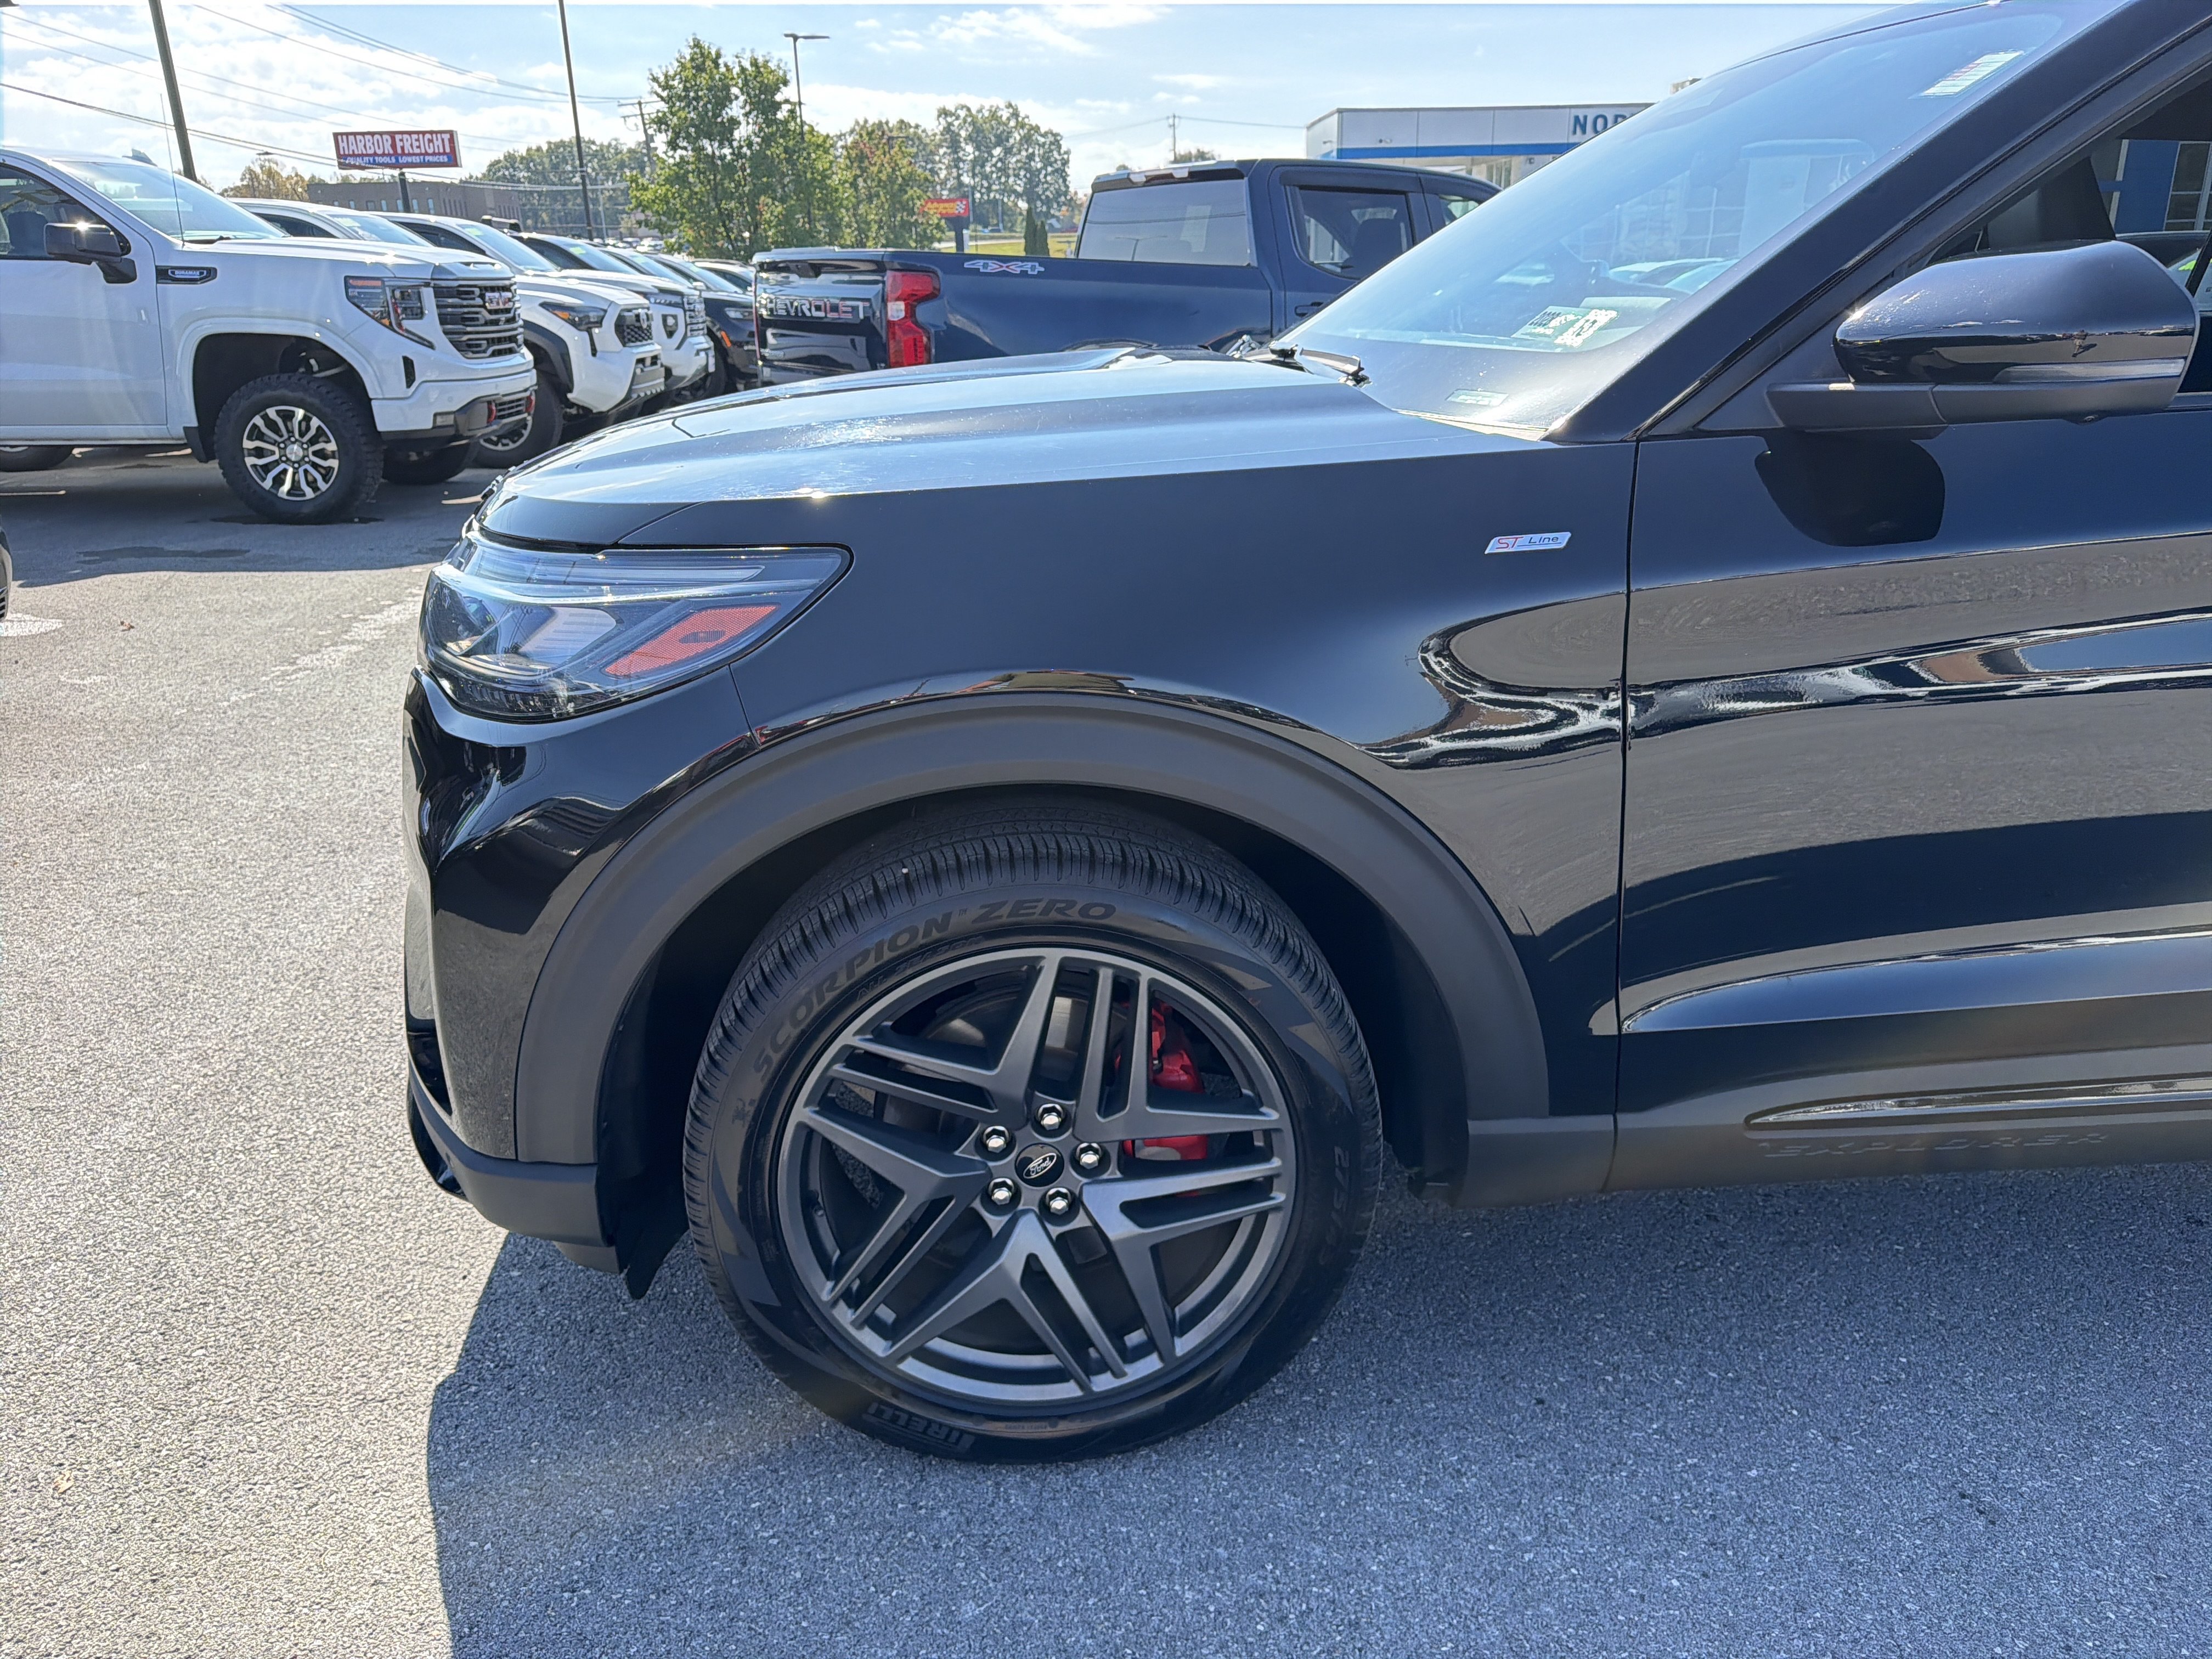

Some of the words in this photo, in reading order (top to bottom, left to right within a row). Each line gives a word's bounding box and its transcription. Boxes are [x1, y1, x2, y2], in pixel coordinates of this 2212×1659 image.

[338, 134, 393, 155] HARBOR
[396, 133, 450, 154] FREIGHT
[375, 155, 396, 163] TOOLS
[399, 155, 424, 163] LOWEST
[425, 154, 448, 163] PRICES
[1495, 537, 1525, 550] ST
[1528, 536, 1559, 544] Line
[753, 911, 953, 1085] SCORPION
[970, 898, 1116, 925] ZERO
[1029, 1156, 1052, 1177] Ford
